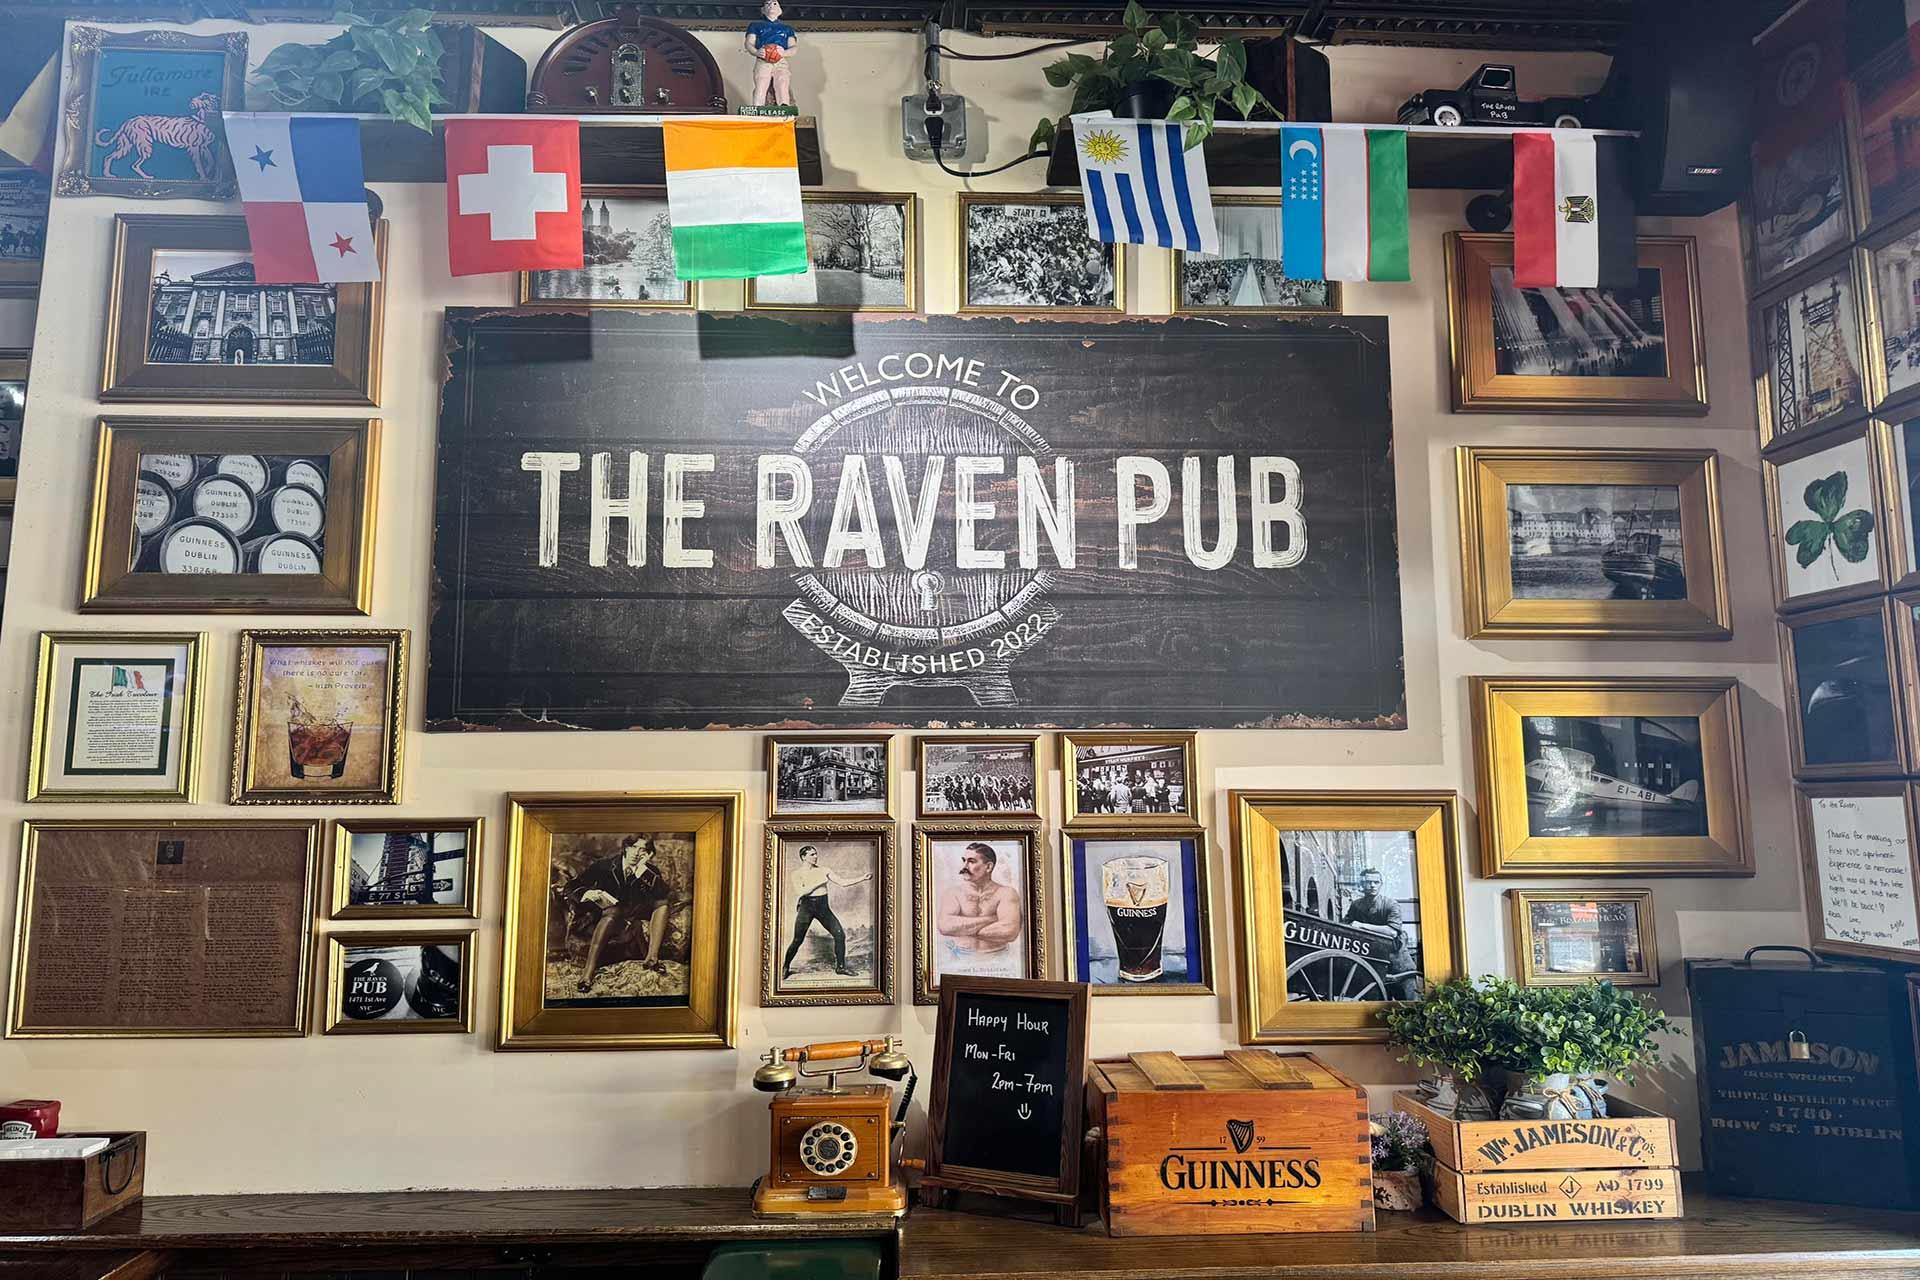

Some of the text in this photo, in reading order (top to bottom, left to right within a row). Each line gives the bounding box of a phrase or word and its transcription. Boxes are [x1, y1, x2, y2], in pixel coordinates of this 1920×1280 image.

[1013, 208, 1036, 217] START
[802, 352, 1040, 410] WELCOME TO
[205, 488, 243, 498] GUINNESS
[520, 450, 1308, 571] THE RAVEN PUB
[179, 535, 226, 549] GUINNESS
[184, 550, 218, 561] DUBLIN
[271, 549, 312, 560] GUINNESS
[277, 562, 307, 571] DUBLIN
[800, 613, 1050, 675] ESTABLISHED 2022
[1616, 784, 1657, 801] EI-ABI
[1827, 828, 1850, 840] Thanks
[1853, 830, 1863, 840] for
[1866, 833, 1892, 847] making
[379, 892, 390, 900] 77
[1117, 907, 1157, 918] GUINNESS
[1283, 920, 1371, 956] GUINNESS
[351, 981, 388, 994] PUB
[1720, 1039, 1881, 1075] JAMSON
[1743, 1069, 1785, 1080] IRISH
[1718, 1089, 1770, 1101] TRIPLE
[1773, 1092, 1847, 1106] DISTILLED
[1775, 1105, 1833, 1121] 1780
[1711, 1117, 1761, 1131] BOW
[1813, 1124, 1904, 1141] DUBLIN
[1219, 1136, 1227, 1144] 17
[1256, 1136, 1266, 1144] 59
[1160, 1154, 1322, 1190] GUINNESS
[1477, 1180, 1547, 1195] Established
[1565, 1180, 1575, 1194] J
[1628, 1178, 1664, 1191] 1799
[1478, 1200, 1666, 1219] DUBLIN WHISKEY
